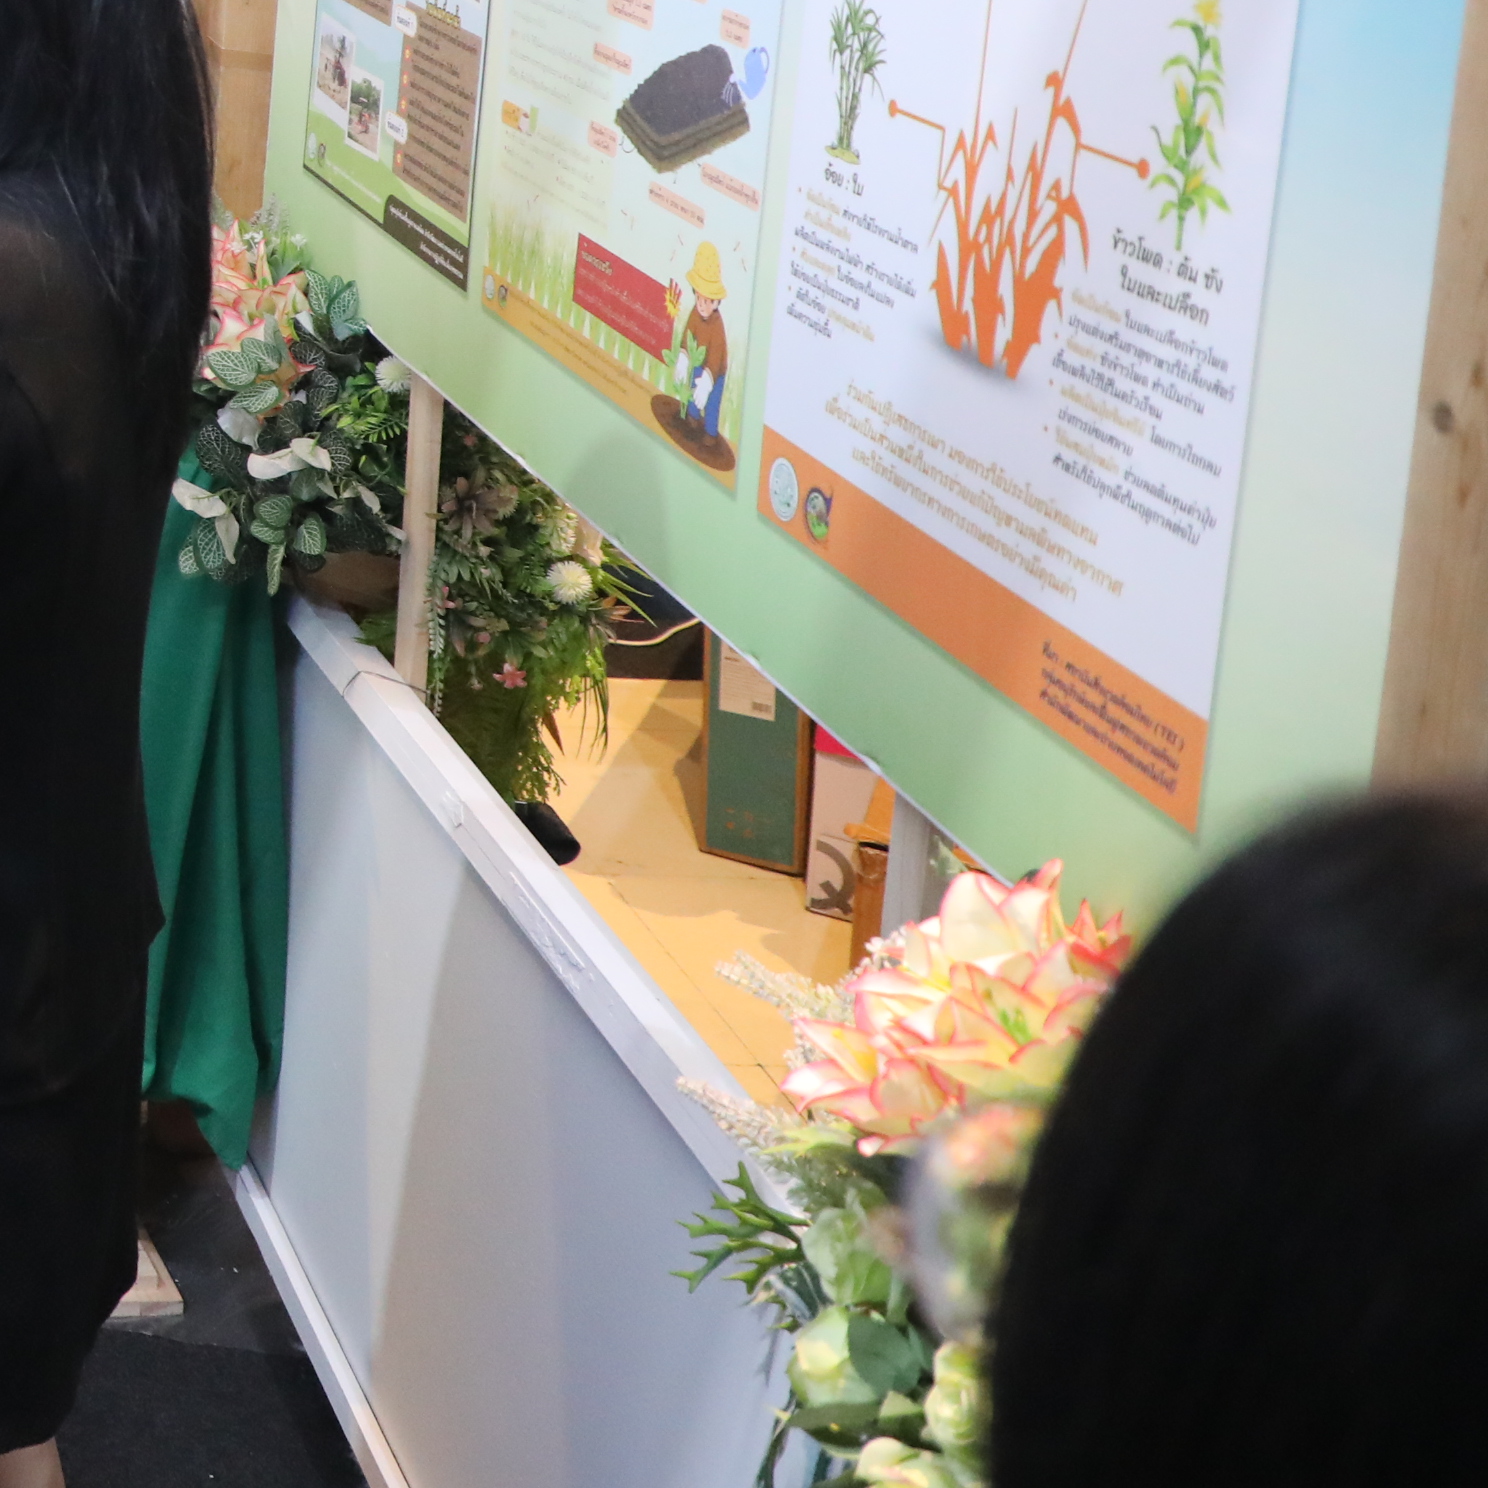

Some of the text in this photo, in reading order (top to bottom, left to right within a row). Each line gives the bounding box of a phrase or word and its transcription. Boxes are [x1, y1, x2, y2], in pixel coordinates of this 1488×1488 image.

[852, 172, 864, 196] ใบ
[1112, 227, 1164, 271] ข้าวโพด
[1177, 256, 1198, 286] ต้น
[1121, 265, 1210, 327] ใบและเปลือก
